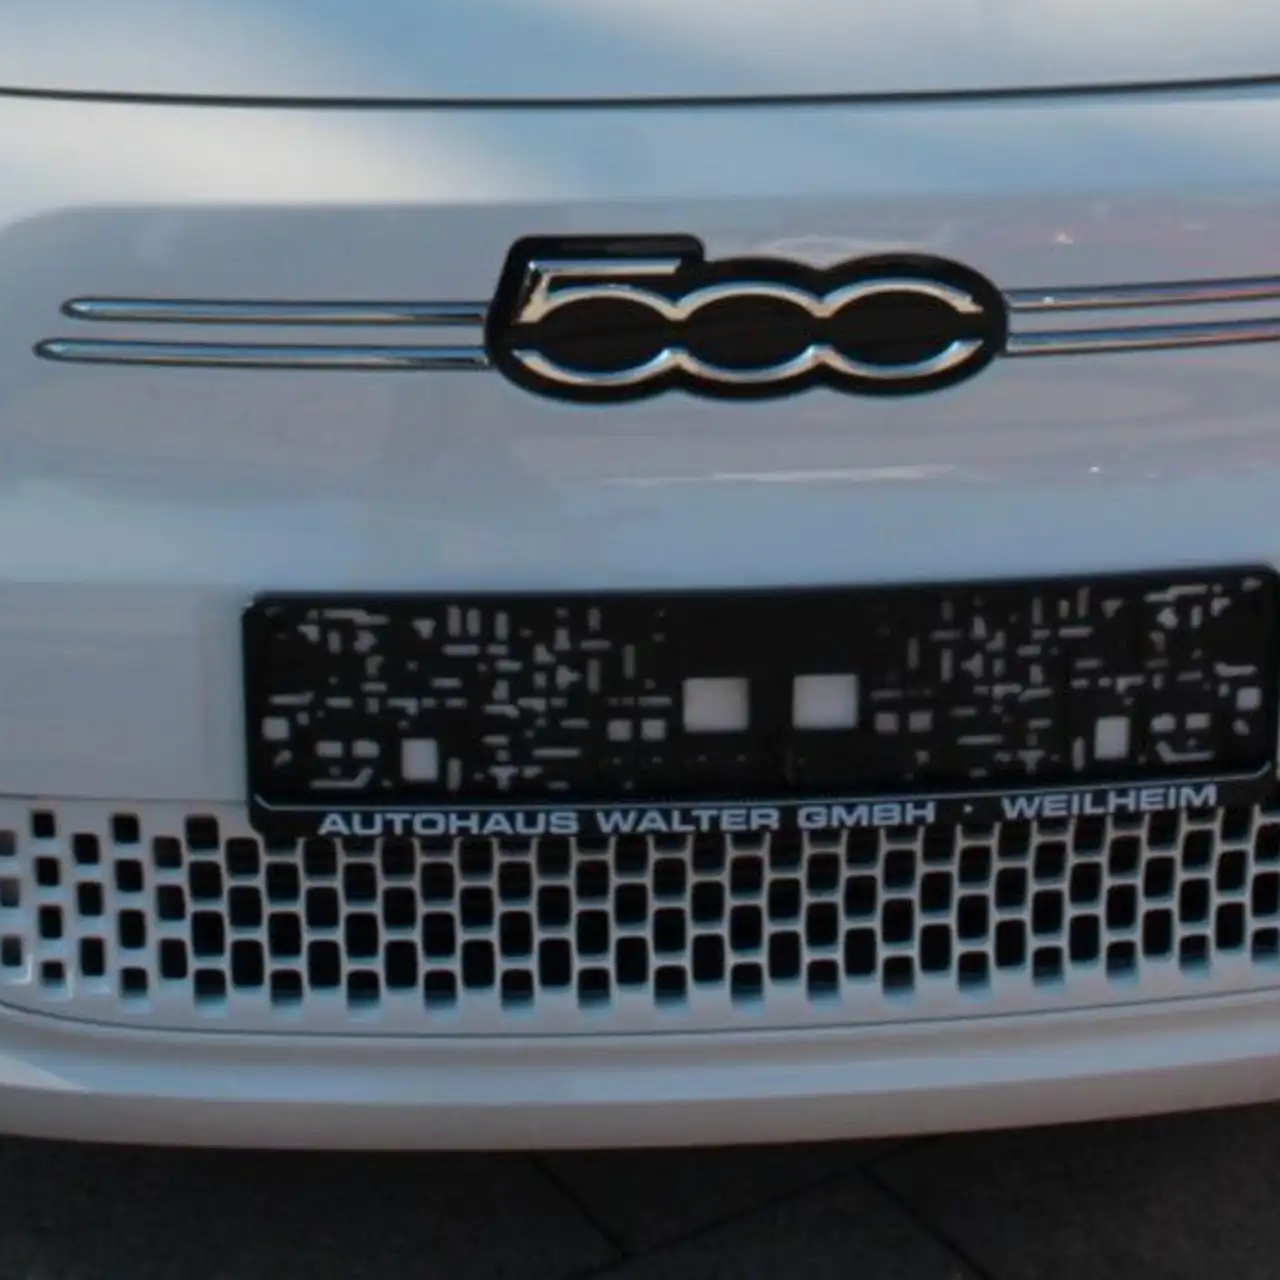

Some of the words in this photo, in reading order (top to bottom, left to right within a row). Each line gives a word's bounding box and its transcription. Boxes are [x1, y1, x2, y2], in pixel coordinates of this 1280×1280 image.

[508, 252, 988, 389] 500
[317, 811, 579, 837] AUTOHAUS
[596, 808, 780, 835] WALTER
[797, 801, 936, 830] GMBH
[1001, 782, 1218, 820] WEILHEIM
